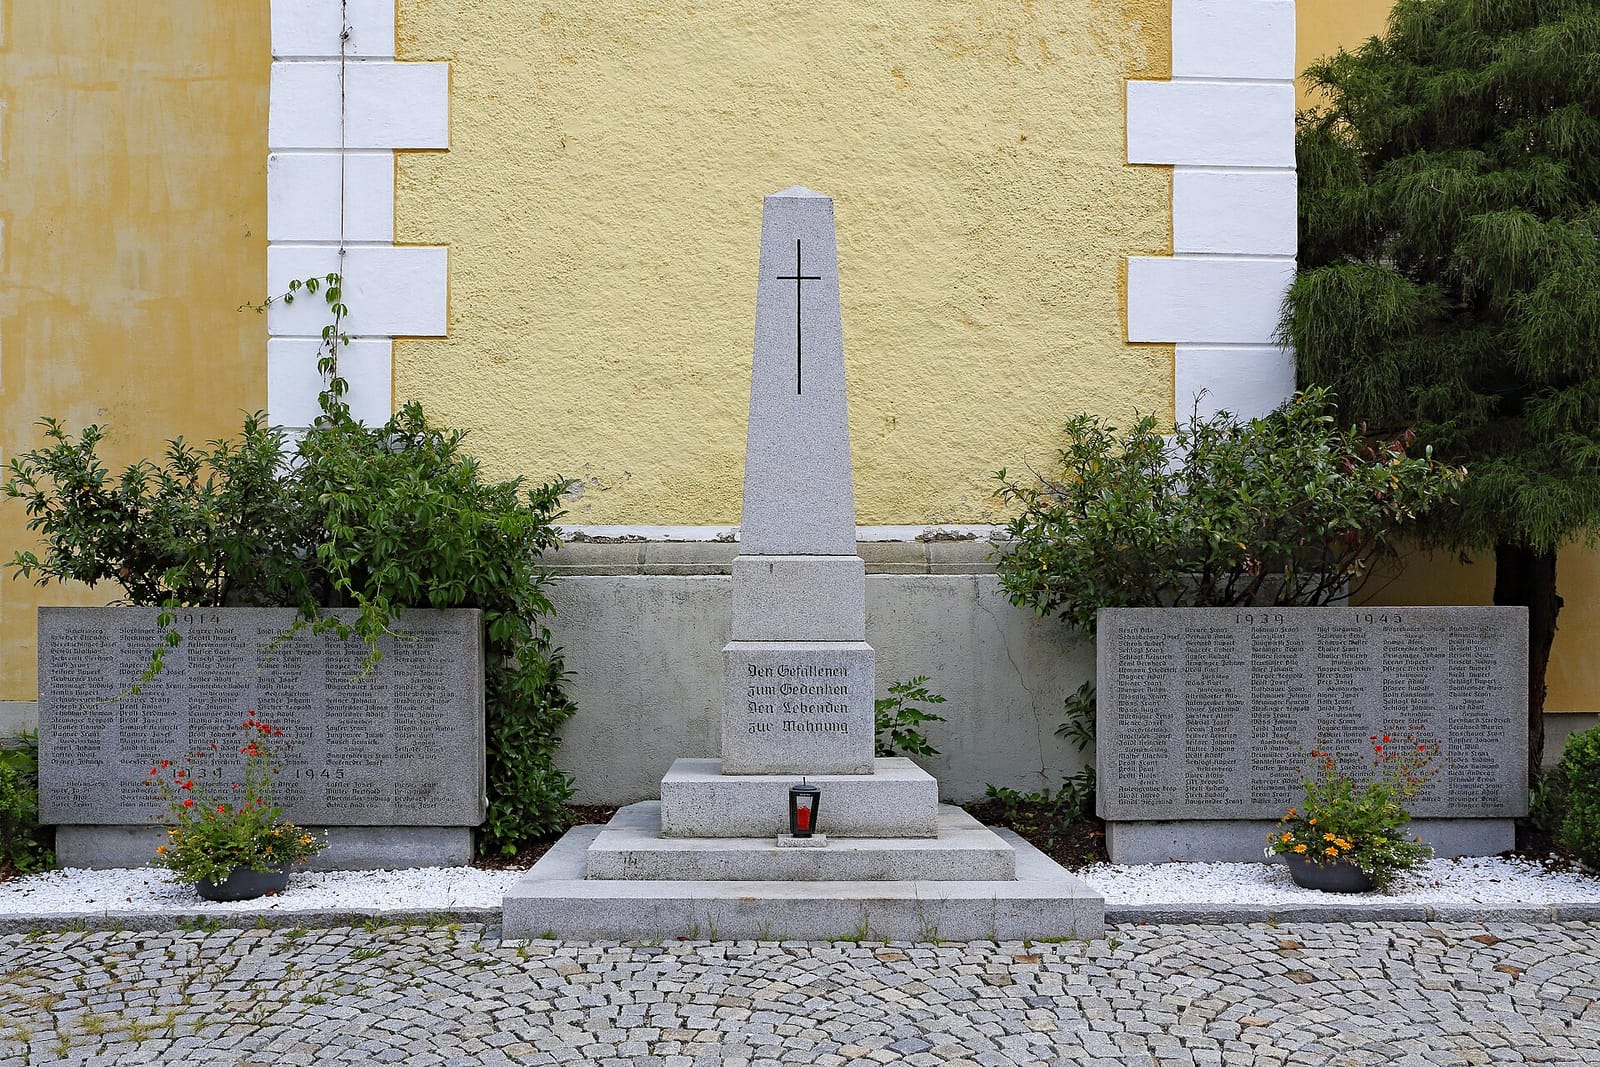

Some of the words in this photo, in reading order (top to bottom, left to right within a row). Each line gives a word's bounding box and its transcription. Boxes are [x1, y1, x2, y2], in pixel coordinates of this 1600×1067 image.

[174, 614, 219, 625] 1914
[1236, 613, 1284, 625] 1939
[1356, 613, 1402, 624] 1945
[748, 664, 773, 677] Den
[777, 664, 848, 678] Gefallenen
[748, 684, 776, 698] zum
[780, 683, 849, 696] Gedenken
[748, 701, 773, 714] Den
[782, 701, 848, 714] Lebenden
[748, 721, 774, 734] zur
[782, 720, 849, 735] Mahnung
[296, 768, 344, 779] 1945
